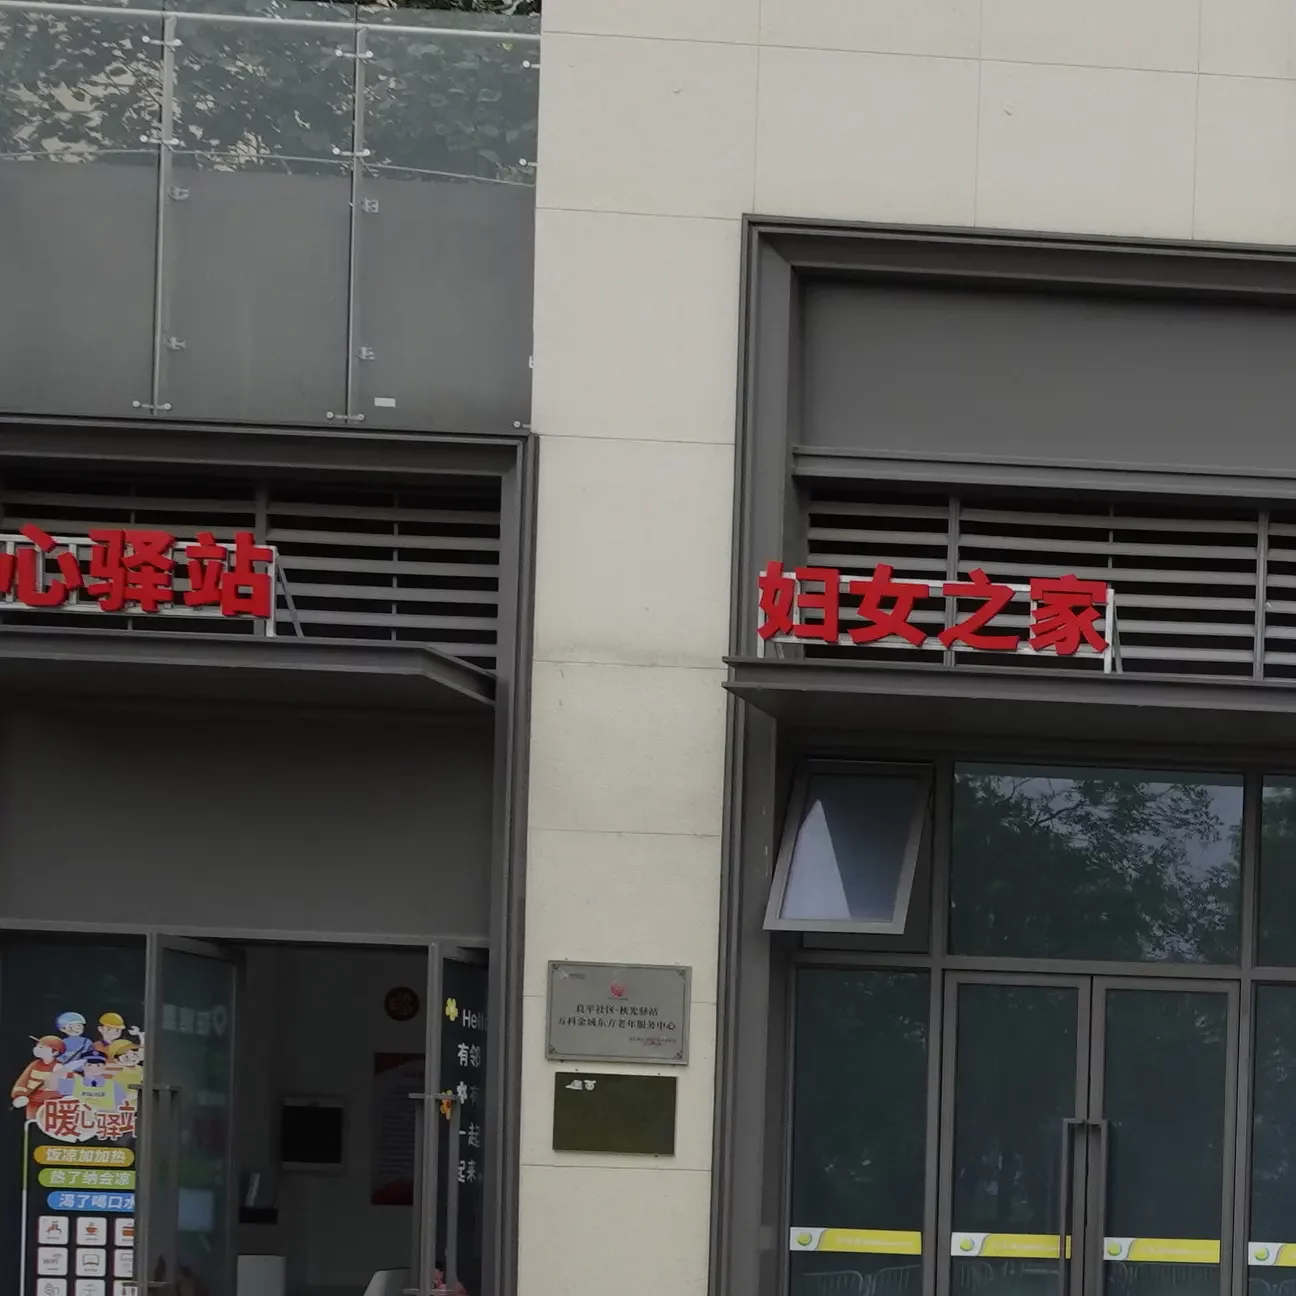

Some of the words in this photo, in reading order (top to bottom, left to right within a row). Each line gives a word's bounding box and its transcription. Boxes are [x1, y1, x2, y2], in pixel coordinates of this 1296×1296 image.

[0, 523, 273, 618] 心驿站
[757, 561, 1109, 655] 妇女之家
